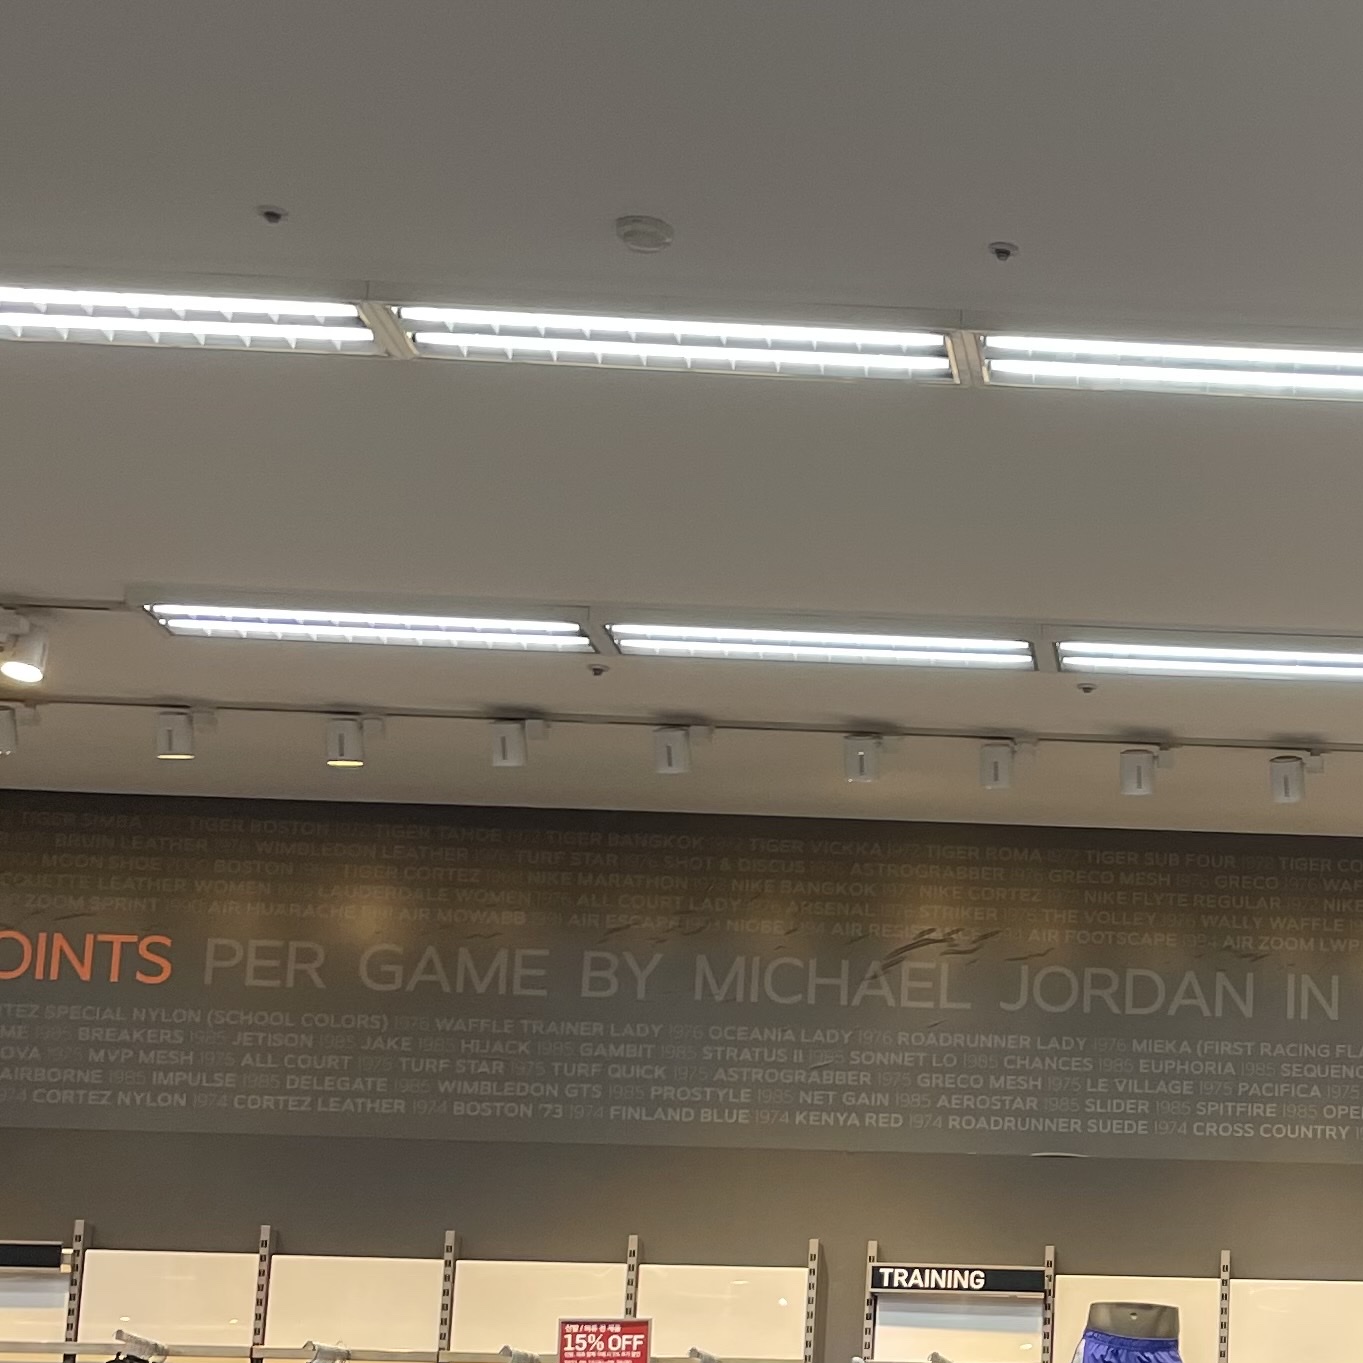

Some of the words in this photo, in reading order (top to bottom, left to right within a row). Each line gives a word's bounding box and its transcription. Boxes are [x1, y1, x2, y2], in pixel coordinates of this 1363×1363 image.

[203, 937, 326, 990] PER
[358, 943, 550, 998] GAME
[580, 950, 665, 1001] BY
[693, 954, 972, 1010] MICHAEL
[999, 964, 1255, 1020] JORDAN
[1286, 972, 1340, 1022] IN
[77, 1026, 184, 1044] BREAKERS
[360, 1035, 413, 1052] JAKE
[578, 1042, 655, 1059] GAMBIT
[701, 1045, 789, 1063] STRATUS
[848, 1050, 927, 1067] SONNET
[1003, 1055, 1094, 1072] CHANCES
[1138, 1059, 1236, 1076] EUPHORIA
[206, 1010, 296, 1027] (SCHOOL
[300, 1012, 390, 1030] COLORS)
[435, 1017, 514, 1033] WAFFLE
[520, 1019, 604, 1037] TRAINER
[610, 1022, 665, 1039] LADY
[708, 1025, 795, 1043] OCEANIA
[800, 1029, 853, 1044] LADY
[897, 1032, 1032, 1050] ROADRUNNER
[1036, 1036, 1088, 1052] LADY
[1260, 1042, 1331, 1058] RACING
[0, 1066, 104, 1083] AIRBORNE
[151, 1071, 237, 1088] IMPULSE
[285, 1075, 388, 1093] DELEGATE
[437, 1079, 559, 1097] WIMBLEDON
[563, 1082, 603, 1099] GTS
[649, 1086, 753, 1104] PROSTYLE
[798, 1090, 836, 1106] NET
[839, 1091, 890, 1106] GAIN
[935, 1094, 1039, 1111] AEROSTAR
[1083, 1098, 1151, 1114] SLIDER
[1195, 1101, 1278, 1118] SPITFIRE
[87, 1047, 133, 1064] MVP
[138, 1049, 194, 1066] MESH
[240, 1053, 279, 1068] ALL
[283, 1053, 353, 1070] COURT
[398, 1057, 451, 1073] TURF
[454, 1058, 504, 1075] STAR
[550, 1061, 602, 1078] TURF
[607, 1064, 667, 1080] QUICK
[713, 1067, 872, 1086] ASTROGRABBER
[916, 1073, 984, 1089] GRECO
[988, 1075, 1043, 1091] MESH
[1086, 1078, 1110, 1094] LE
[1113, 1079, 1195, 1095] VILLAGE
[1237, 1082, 1322, 1099] PACIFICA
[32, 1088, 113, 1106] CORTEZ
[116, 1091, 188, 1107] NYLON
[232, 1094, 313, 1111] CORTEZ
[316, 1096, 407, 1114] LEATHER
[452, 1100, 533, 1118] BOSTON
[608, 1106, 696, 1122] FINLAND
[699, 1107, 751, 1124] BLUE
[794, 1111, 861, 1127] KENYA
[864, 1112, 904, 1128] RED
[946, 1115, 1084, 1133] ROADRUNNER
[1086, 1118, 1149, 1135] SUEDE
[1191, 1121, 1255, 1138] CROSS
[1258, 1123, 1351, 1141] COUNTRY
[879, 1268, 986, 1290] TRAINING
[564, 1334, 604, 1351] 15%
[608, 1334, 645, 1351] OFF
